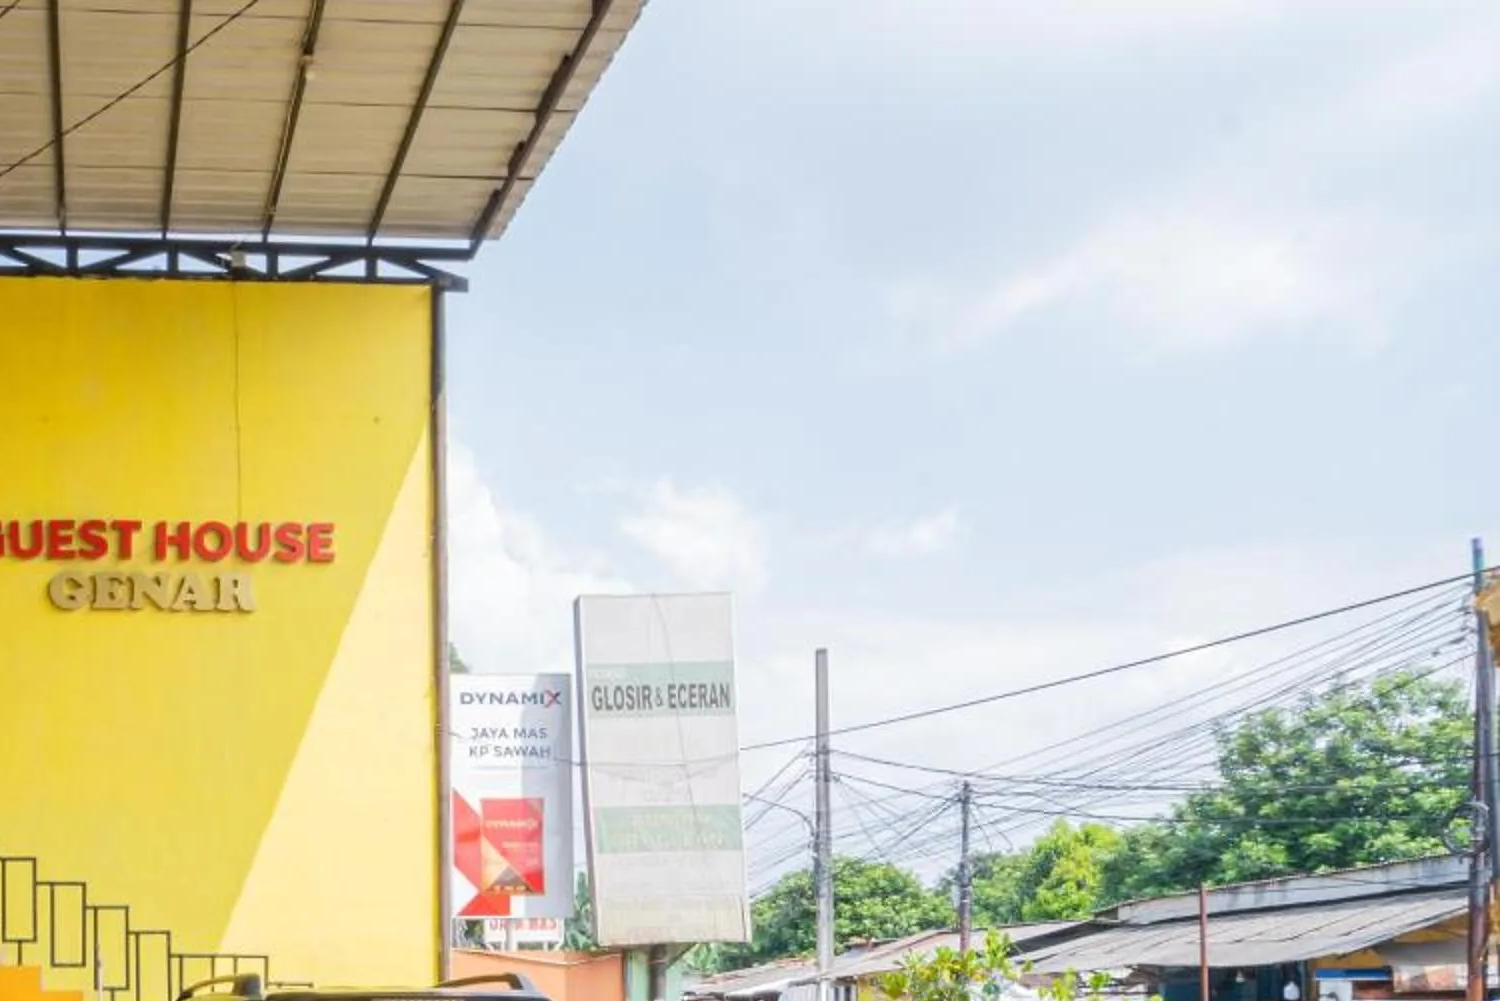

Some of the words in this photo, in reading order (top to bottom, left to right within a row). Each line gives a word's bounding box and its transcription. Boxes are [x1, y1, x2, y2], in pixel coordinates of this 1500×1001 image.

[153, 519, 336, 563] HOUSE
[46, 571, 257, 613] GENAR
[459, 689, 562, 707] DYNAMIX
[591, 684, 653, 712] GLOSIR
[667, 683, 731, 710] ECERAN
[470, 726, 508, 740] JAYA
[512, 726, 549, 740] MAS
[493, 745, 551, 760] SAWAH
